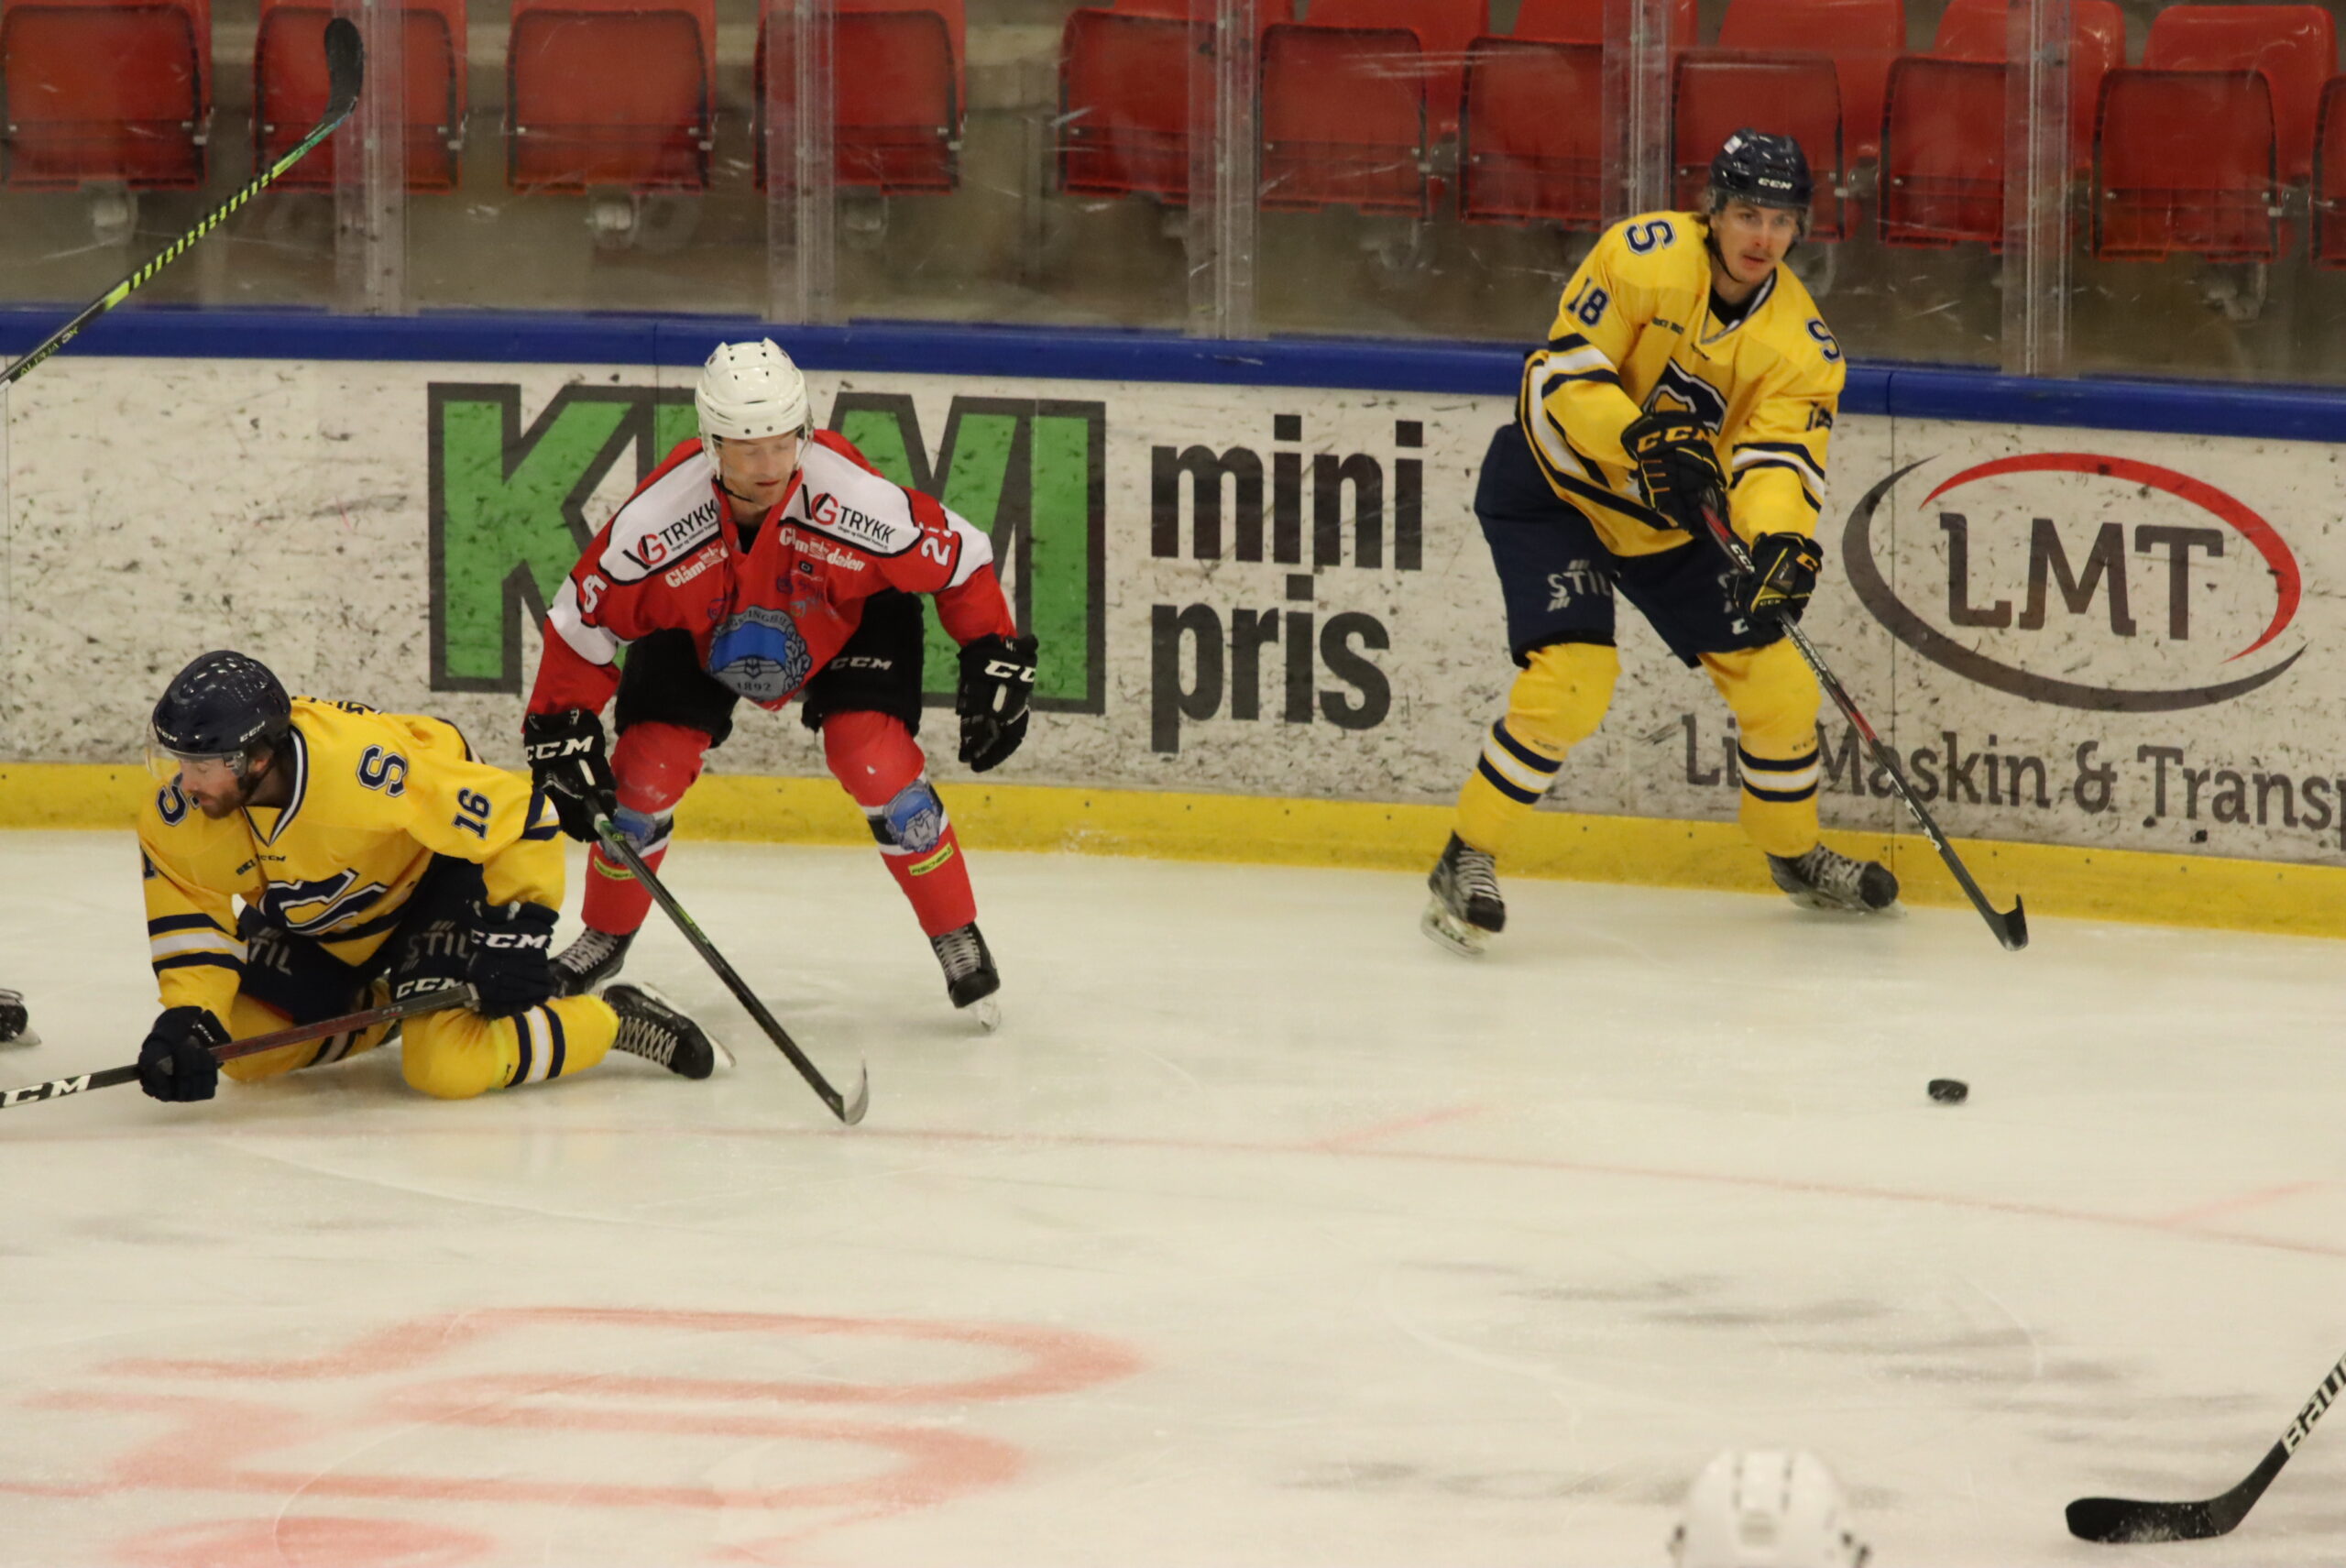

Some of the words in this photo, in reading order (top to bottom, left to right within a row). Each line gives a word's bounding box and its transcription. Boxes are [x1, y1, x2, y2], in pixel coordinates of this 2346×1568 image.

[1757, 176, 1793, 190] CCM
[1623, 219, 1676, 257] S
[1566, 277, 1610, 328] 18
[1151, 413, 1424, 572] mini
[658, 499, 718, 547] TRYKK
[839, 505, 897, 544] TRYKK
[1938, 511, 2225, 641] LMT
[828, 656, 893, 672] CCM
[983, 659, 1037, 684] CC
[1151, 573, 1392, 754] pris
[737, 682, 772, 692] 1892
[240, 720, 266, 743] CCM
[356, 743, 410, 798] S
[1681, 712, 1741, 789] Li
[2072, 740, 2117, 813] &
[2136, 743, 2346, 852] Trans
[451, 786, 492, 840] 16
[247, 936, 293, 977] TIL
[470, 927, 549, 949] CCM
[2, 1073, 93, 1109] CM
